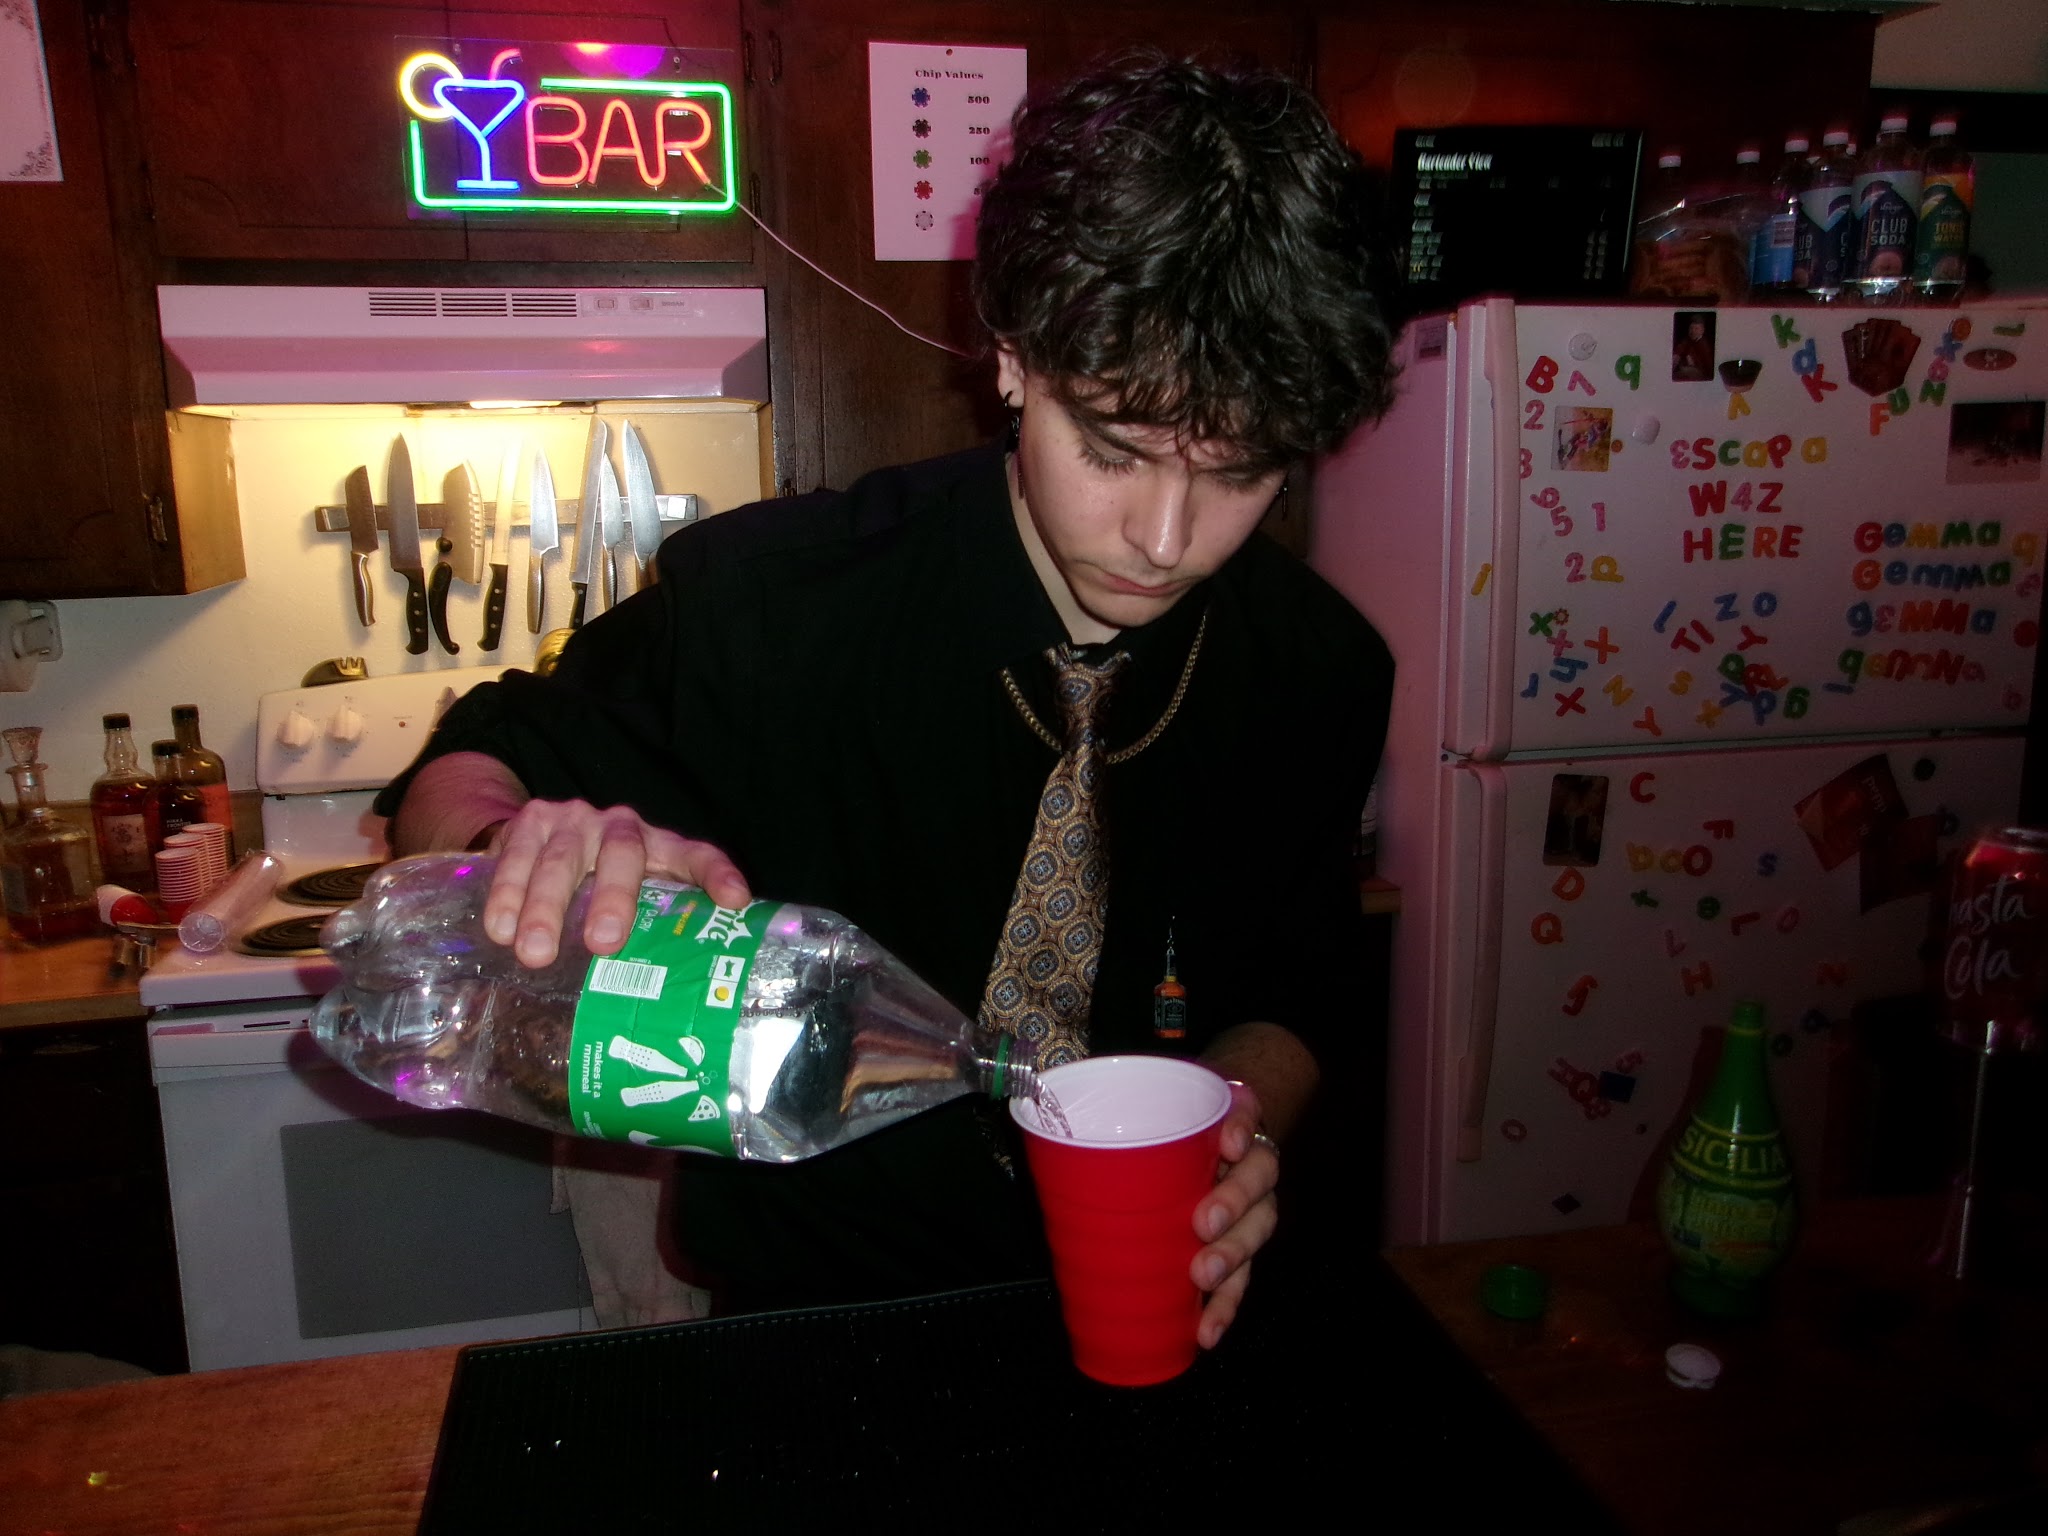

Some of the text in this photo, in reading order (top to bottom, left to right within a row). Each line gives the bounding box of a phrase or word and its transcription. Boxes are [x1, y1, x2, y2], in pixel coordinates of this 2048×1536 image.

[915, 69, 984, 80] Chip Values
[967, 95, 990, 105] 500
[524, 96, 712, 187] BAR
[968, 126, 990, 135] 250
[970, 157, 990, 165] 100
[1870, 235, 1906, 246] SODA
[1871, 218, 1908, 235] CLUB
[1526, 355, 1559, 393] B
[1524, 400, 1545, 430] 2
[1683, 523, 1803, 563] HERE
[1630, 772, 1656, 803] C
[1944, 935, 2025, 1000] Cola
[582, 1044, 592, 1094] mmmeal
[593, 1041, 604, 1099] makes it a
[1679, 1124, 1787, 1175] SICILIA
